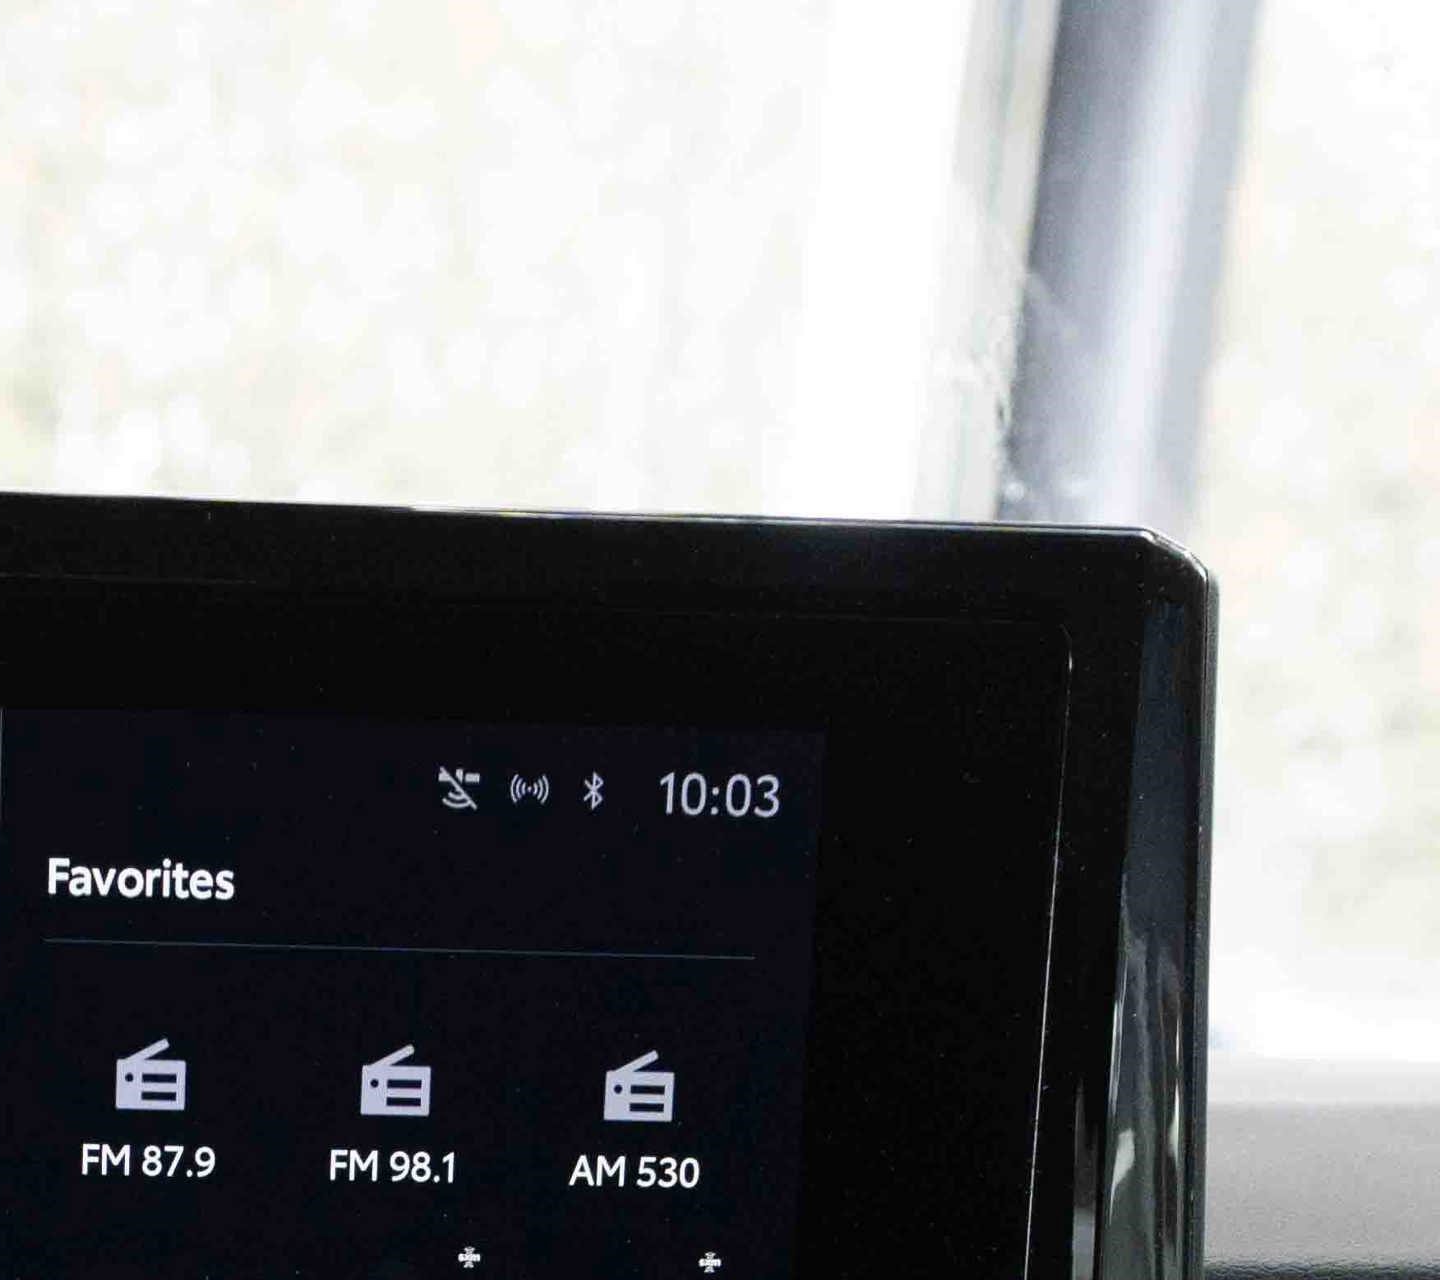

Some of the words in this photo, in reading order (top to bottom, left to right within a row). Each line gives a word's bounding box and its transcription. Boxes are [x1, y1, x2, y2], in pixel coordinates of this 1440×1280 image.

[659, 771, 780, 818] 10:03
[47, 857, 235, 901] Favorites
[81, 1143, 131, 1177] FM
[141, 1144, 216, 1178] 87.9
[329, 1148, 379, 1182] FM
[389, 1150, 455, 1184] 98.1
[568, 1154, 627, 1188] AM
[636, 1155, 700, 1189] 530
